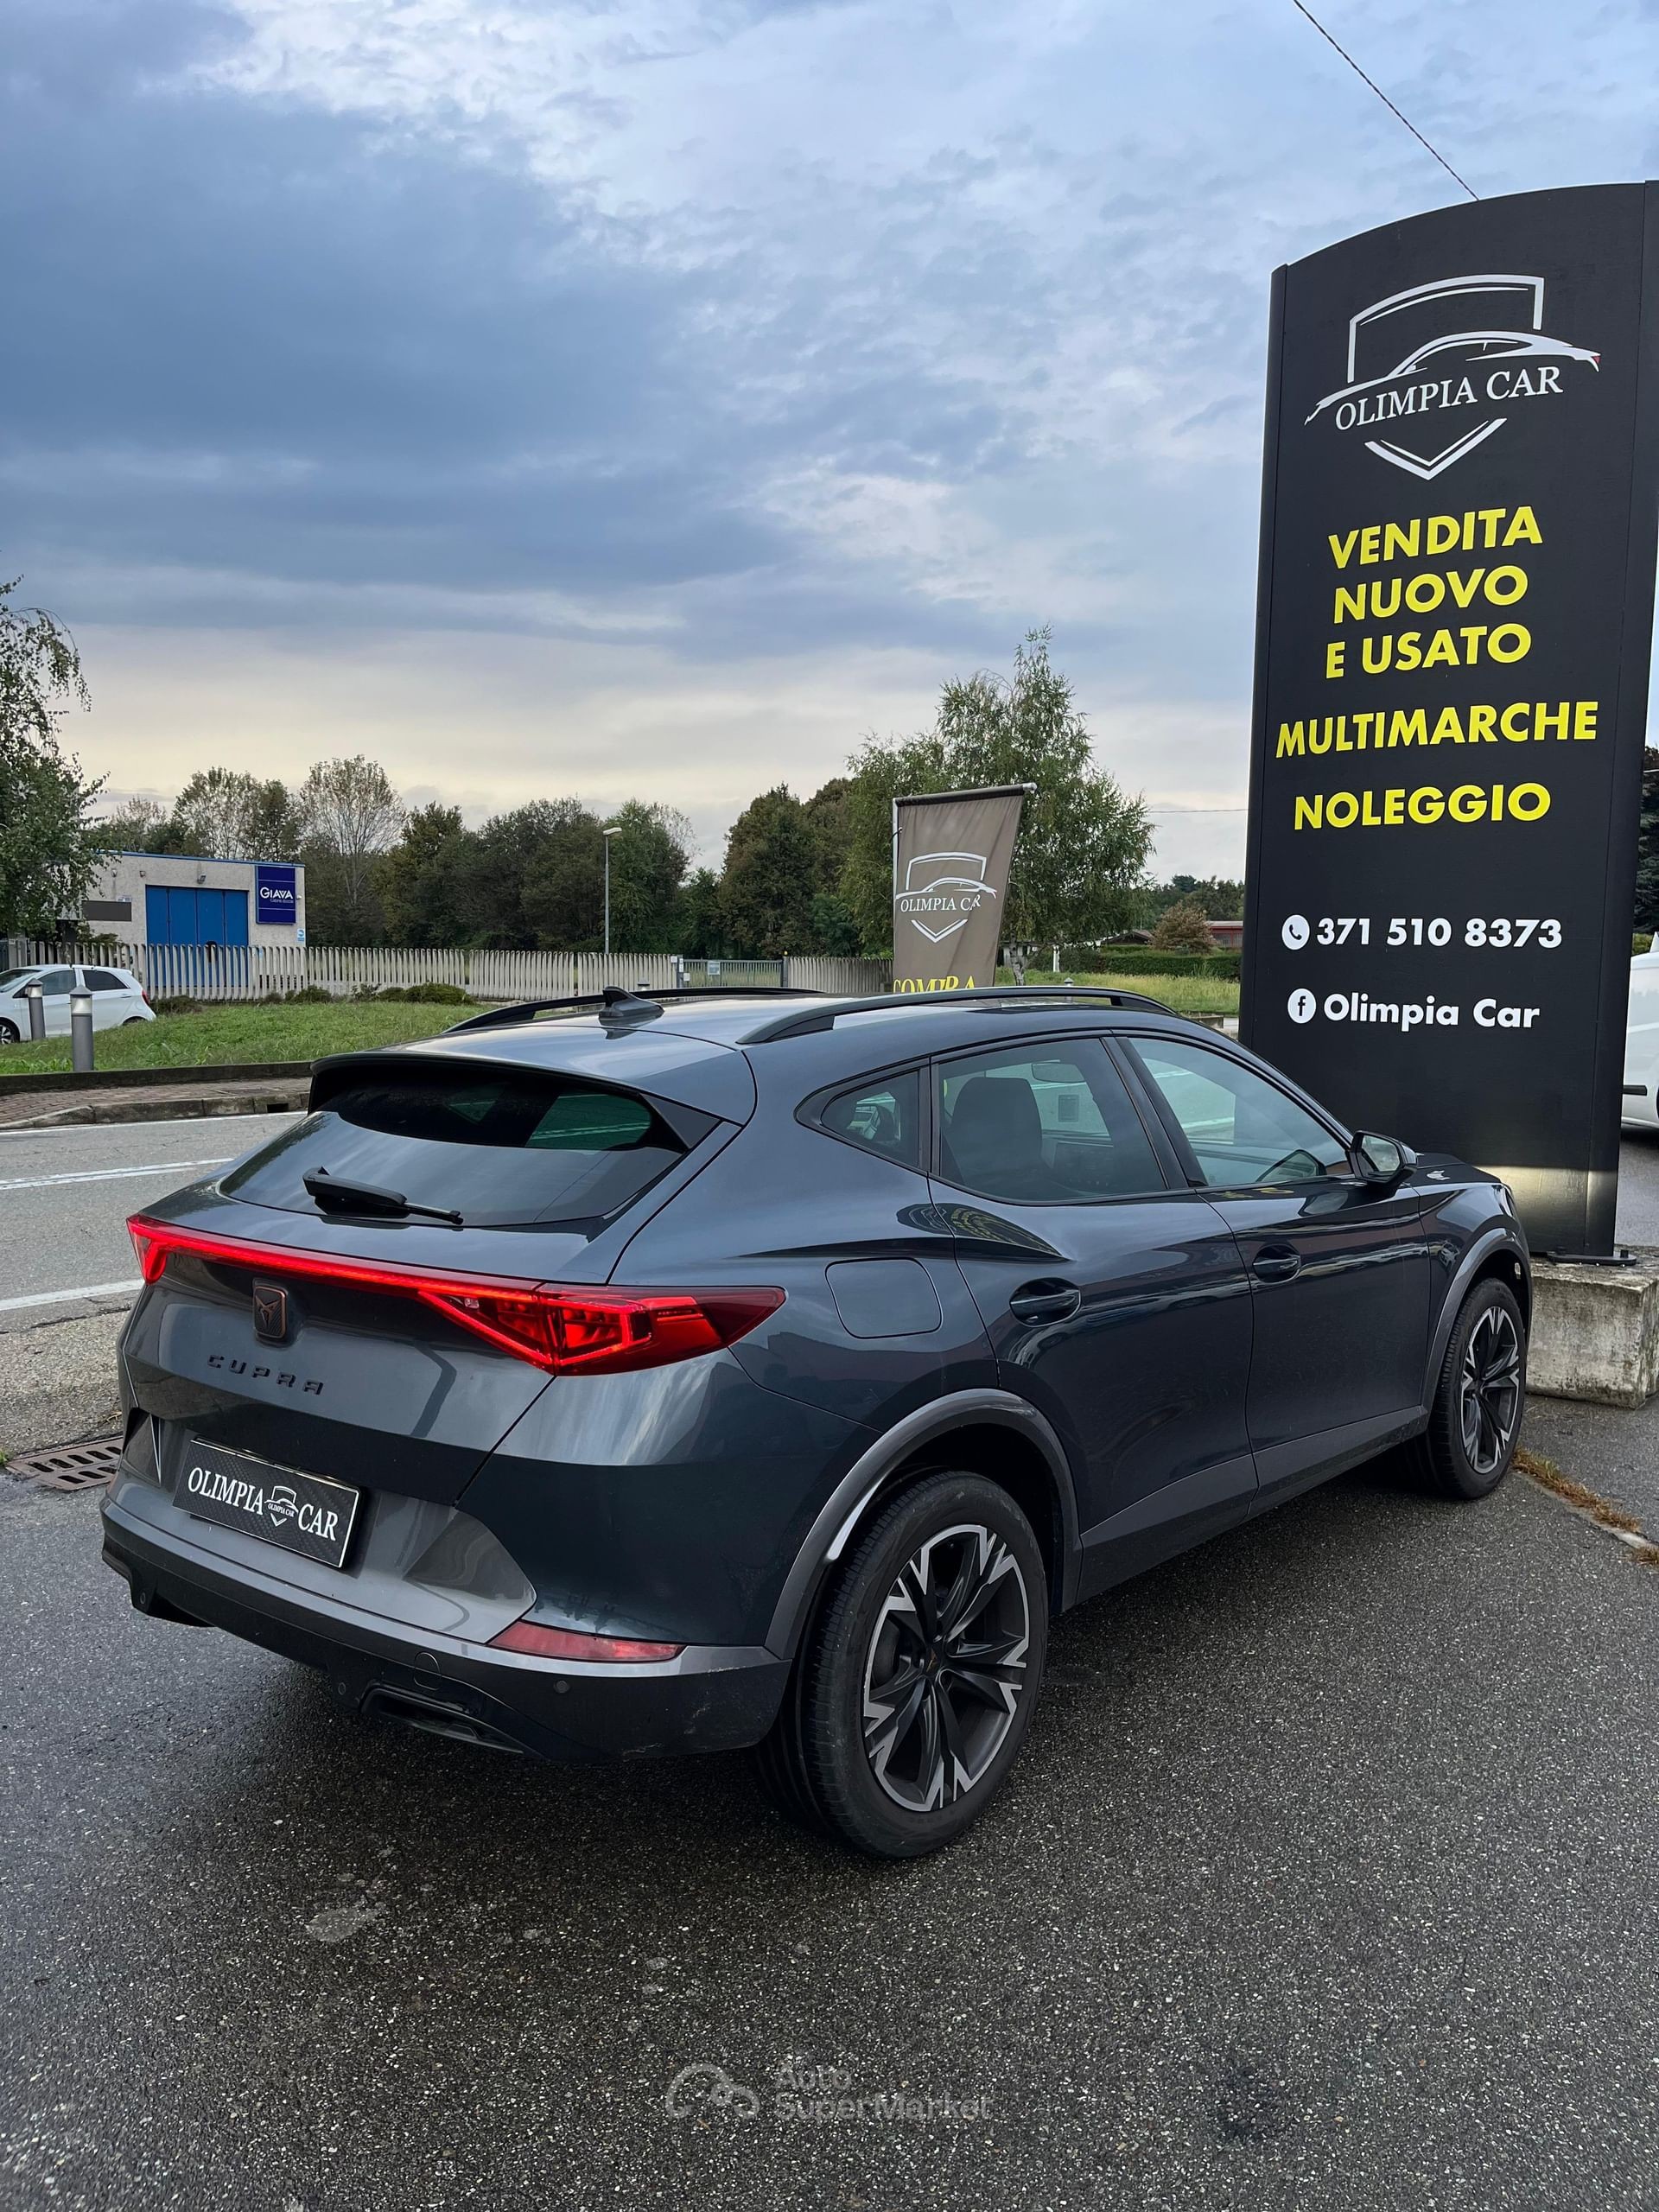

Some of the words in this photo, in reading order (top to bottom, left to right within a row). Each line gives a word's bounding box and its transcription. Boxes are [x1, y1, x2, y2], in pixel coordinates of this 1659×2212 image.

[1335, 376, 1478, 431] OLIMPIA
[1486, 365, 1563, 401] CAR
[1328, 505, 1543, 569] VENDITA
[1333, 565, 1529, 624] NUOVO
[1325, 641, 1346, 679] E
[1362, 623, 1532, 674] USATO
[1275, 701, 1599, 759] MULTIMARCHE
[1294, 782, 1552, 830] NOLEGGIO
[260, 887, 294, 899] GIAVA
[900, 897, 957, 912] OLIMPIA
[1316, 918, 1370, 945] 371
[1386, 918, 1452, 947] 510
[1464, 918, 1562, 949] 8373
[1324, 992, 1459, 1032] Olimpia
[1472, 998, 1541, 1028] Car
[207, 1355, 324, 1395] CUPRA
[188, 1467, 264, 1516] OLIMPIA
[298, 1503, 339, 1541] CAR
